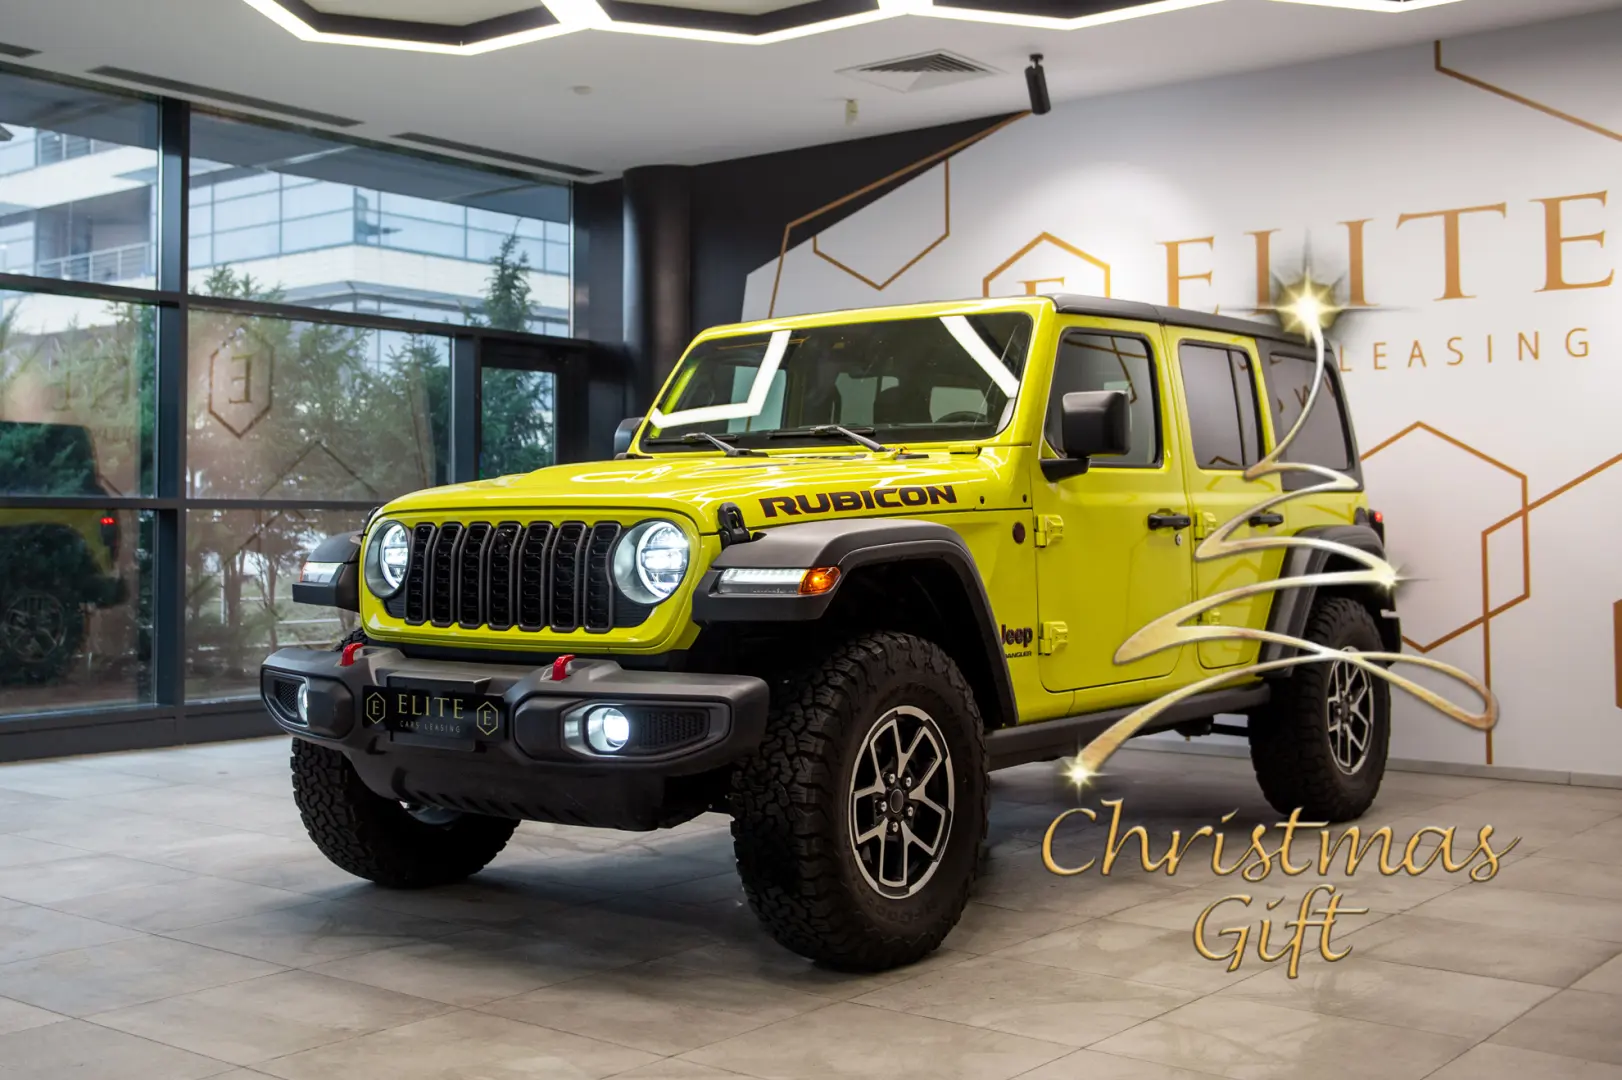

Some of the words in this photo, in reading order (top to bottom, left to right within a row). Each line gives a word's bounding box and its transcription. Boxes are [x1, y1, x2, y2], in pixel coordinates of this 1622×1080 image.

[1338, 327, 1590, 373] LEASING
[758, 485, 958, 518] RUBICON
[1001, 624, 1033, 648] Jeep
[1005, 650, 1032, 659] ANGLER
[371, 700, 380, 716] E
[398, 693, 465, 720] ELITE
[400, 720, 421, 729] CARS
[424, 723, 461, 733] LEASING
[483, 710, 492, 726] E
